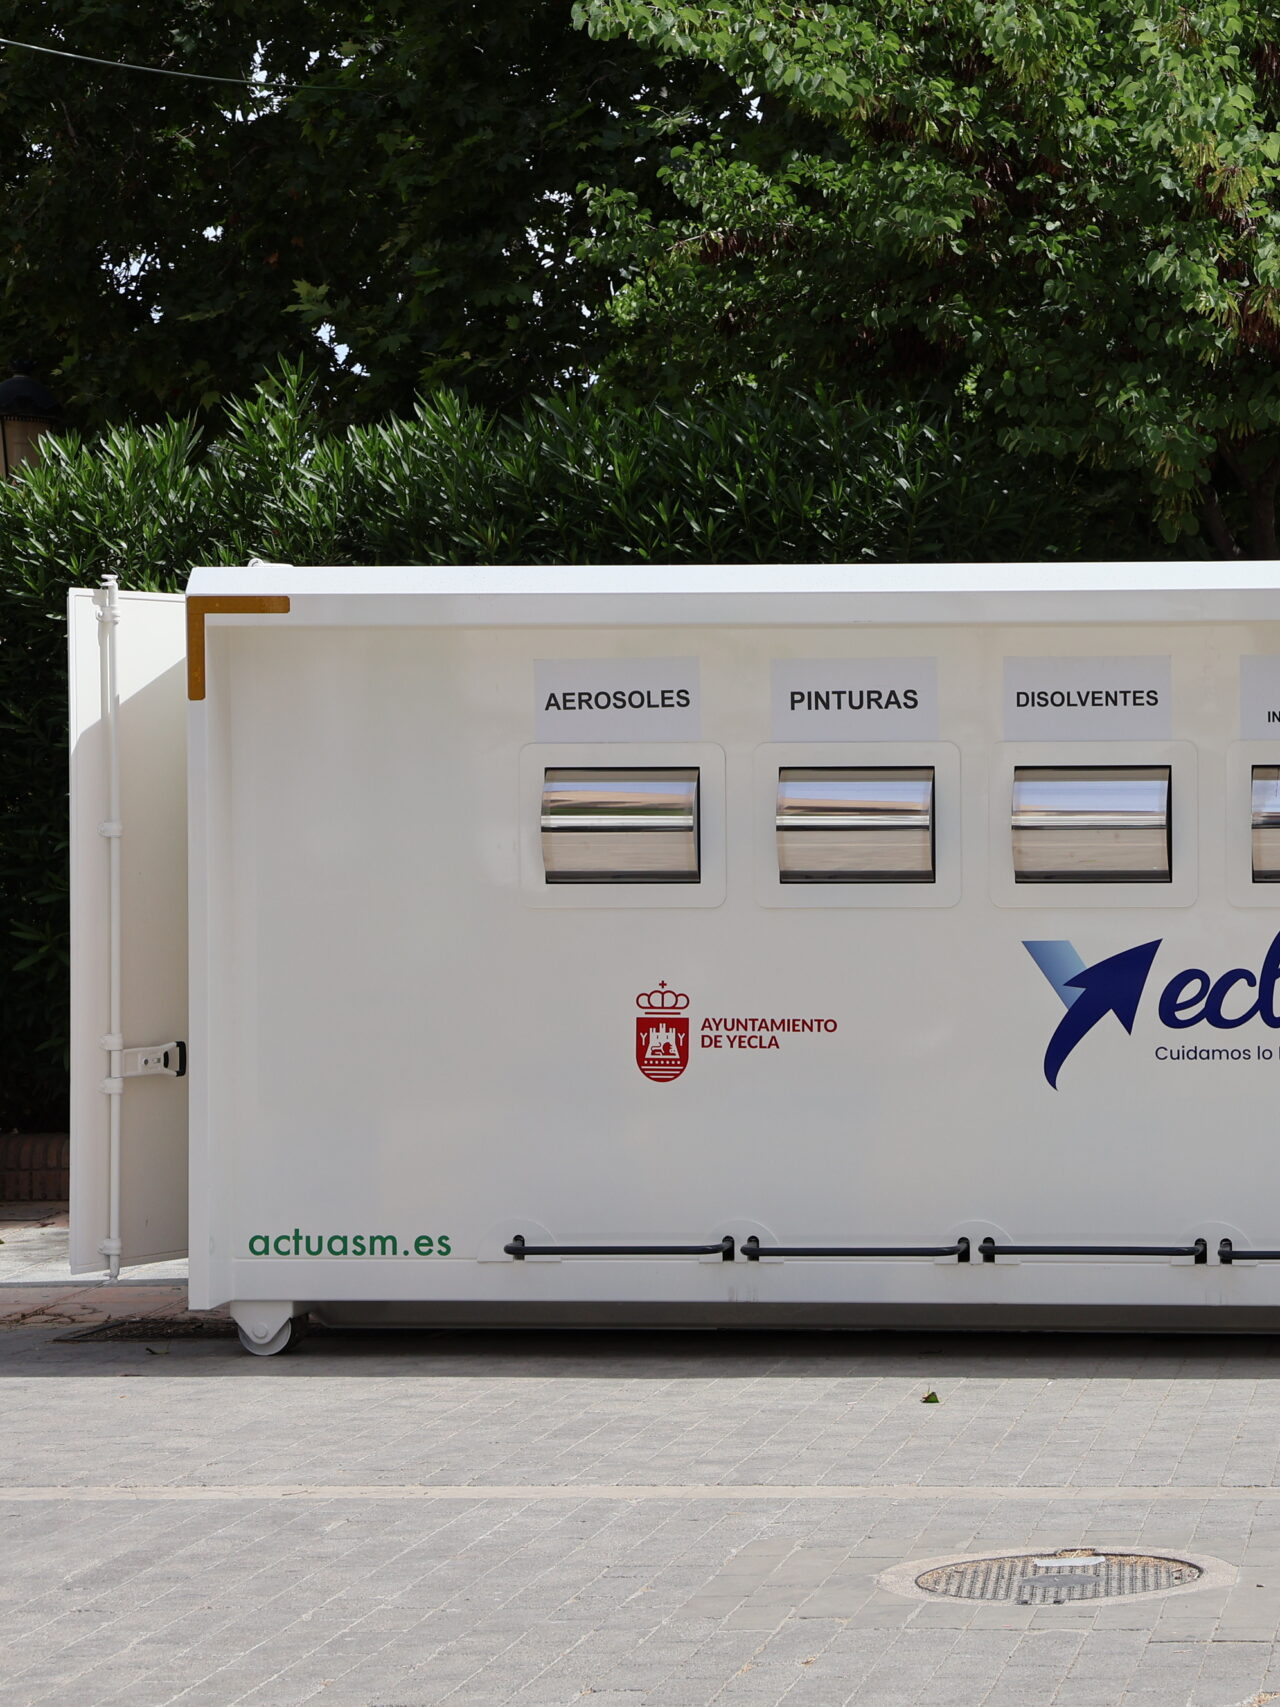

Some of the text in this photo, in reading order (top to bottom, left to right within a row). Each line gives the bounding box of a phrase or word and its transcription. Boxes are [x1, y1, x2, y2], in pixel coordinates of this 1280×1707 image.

[544, 688, 691, 711] AEROSOLES
[789, 688, 919, 711] PINTURAS
[1016, 689, 1159, 708] DISOLVENTES
[701, 1017, 838, 1033] AYUNTAMIENTO
[701, 1034, 780, 1049] DE YECLA
[1155, 1045, 1251, 1061] Cuidamos
[1257, 1045, 1273, 1061] lo
[248, 1228, 452, 1256] actuasm.es
